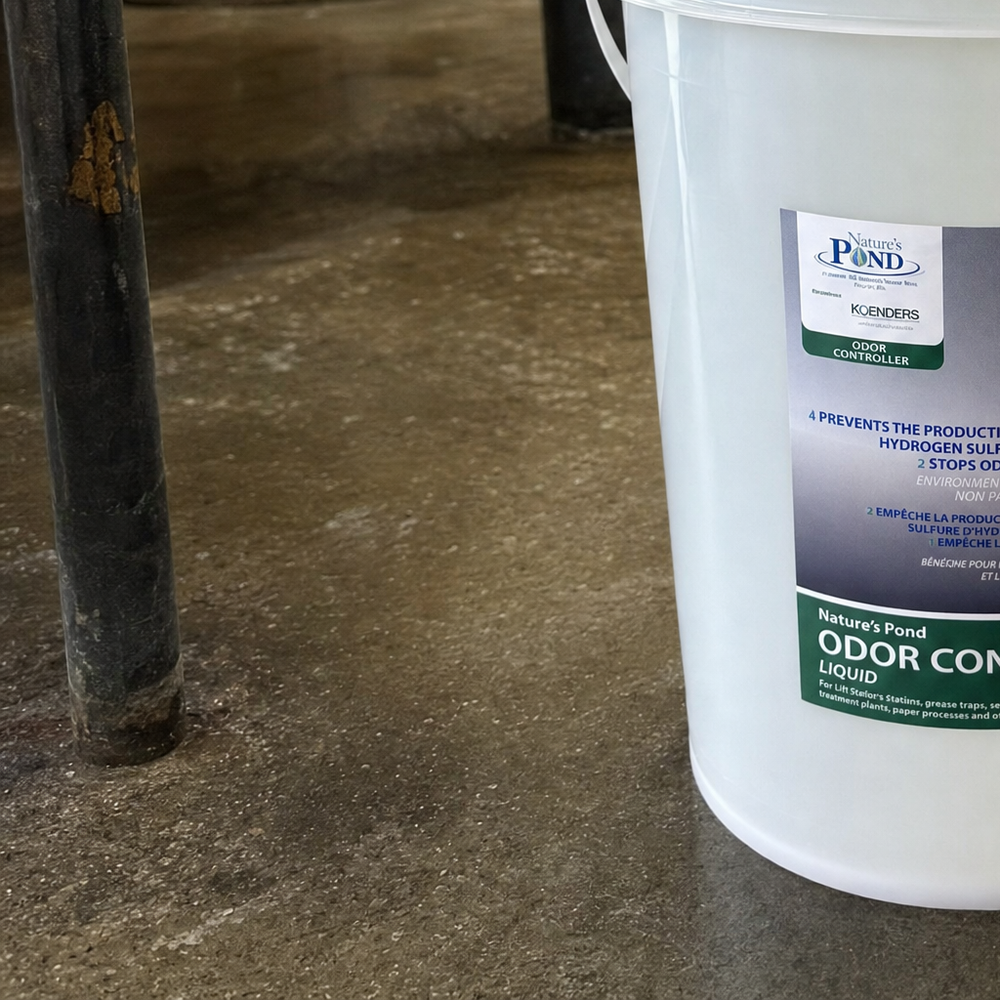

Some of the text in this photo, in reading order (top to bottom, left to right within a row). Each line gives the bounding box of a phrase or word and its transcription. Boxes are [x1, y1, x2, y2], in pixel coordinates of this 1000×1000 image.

[848, 231, 903, 251] Nature's
[851, 303, 920, 320] KOENDERS
[851, 340, 887, 353] ODOR
[833, 348, 909, 366] CONTROLLER
[819, 411, 890, 433] PREVENTS
[892, 422, 920, 436] THE
[879, 437, 962, 454] HYDROGEN
[917, 458, 925, 469] 2
[929, 458, 976, 471] STOPS
[954, 490, 985, 502] NON
[876, 507, 931, 522] EMPÊCHE
[934, 513, 948, 523] LA
[908, 523, 960, 536] SULFURE
[937, 537, 992, 548] EMPÊCHE
[969, 560, 996, 569] POUR
[981, 572, 994, 581] ET
[818, 607, 927, 639] Nature's Pond
[818, 629, 920, 671] ODOR
[819, 659, 878, 684] LIQUID
[819, 679, 833, 690] For
[925, 700, 957, 710] grease
[959, 701, 988, 711] traps,
[819, 690, 860, 707] treatment
[861, 699, 891, 714] plants,
[892, 707, 920, 718] paper
[922, 710, 969, 720] processes
[971, 710, 990, 720] and
